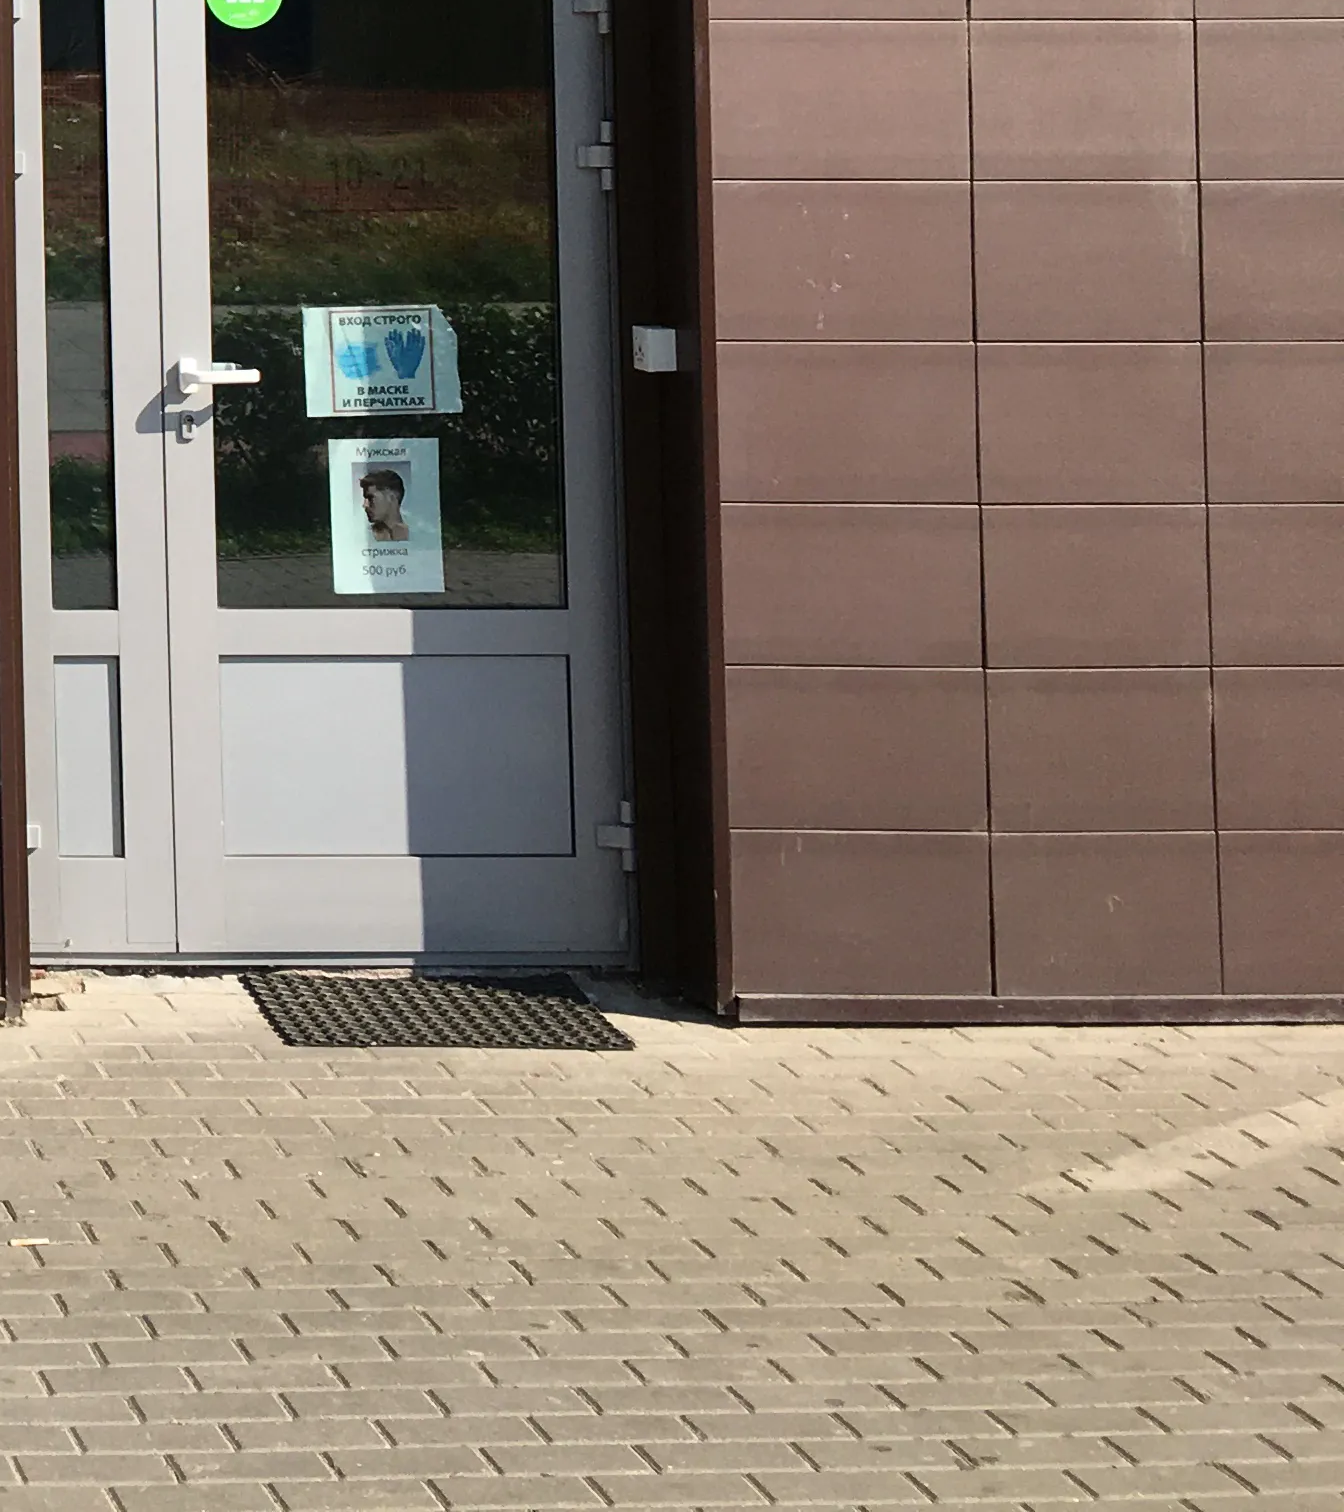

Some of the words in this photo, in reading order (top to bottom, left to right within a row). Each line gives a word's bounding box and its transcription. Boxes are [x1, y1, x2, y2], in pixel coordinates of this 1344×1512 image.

[338, 316, 371, 327] ВХОД
[373, 314, 422, 325] СТРОГО
[357, 386, 365, 395] В
[367, 384, 409, 395] МАСКЕ
[342, 399, 351, 408] И
[354, 396, 425, 408] ПЕРЧАТКАХ
[355, 446, 407, 458] Мужская
[361, 548, 408, 559] стрижка
[362, 565, 383, 576] 500
[385, 564, 407, 578] руб
